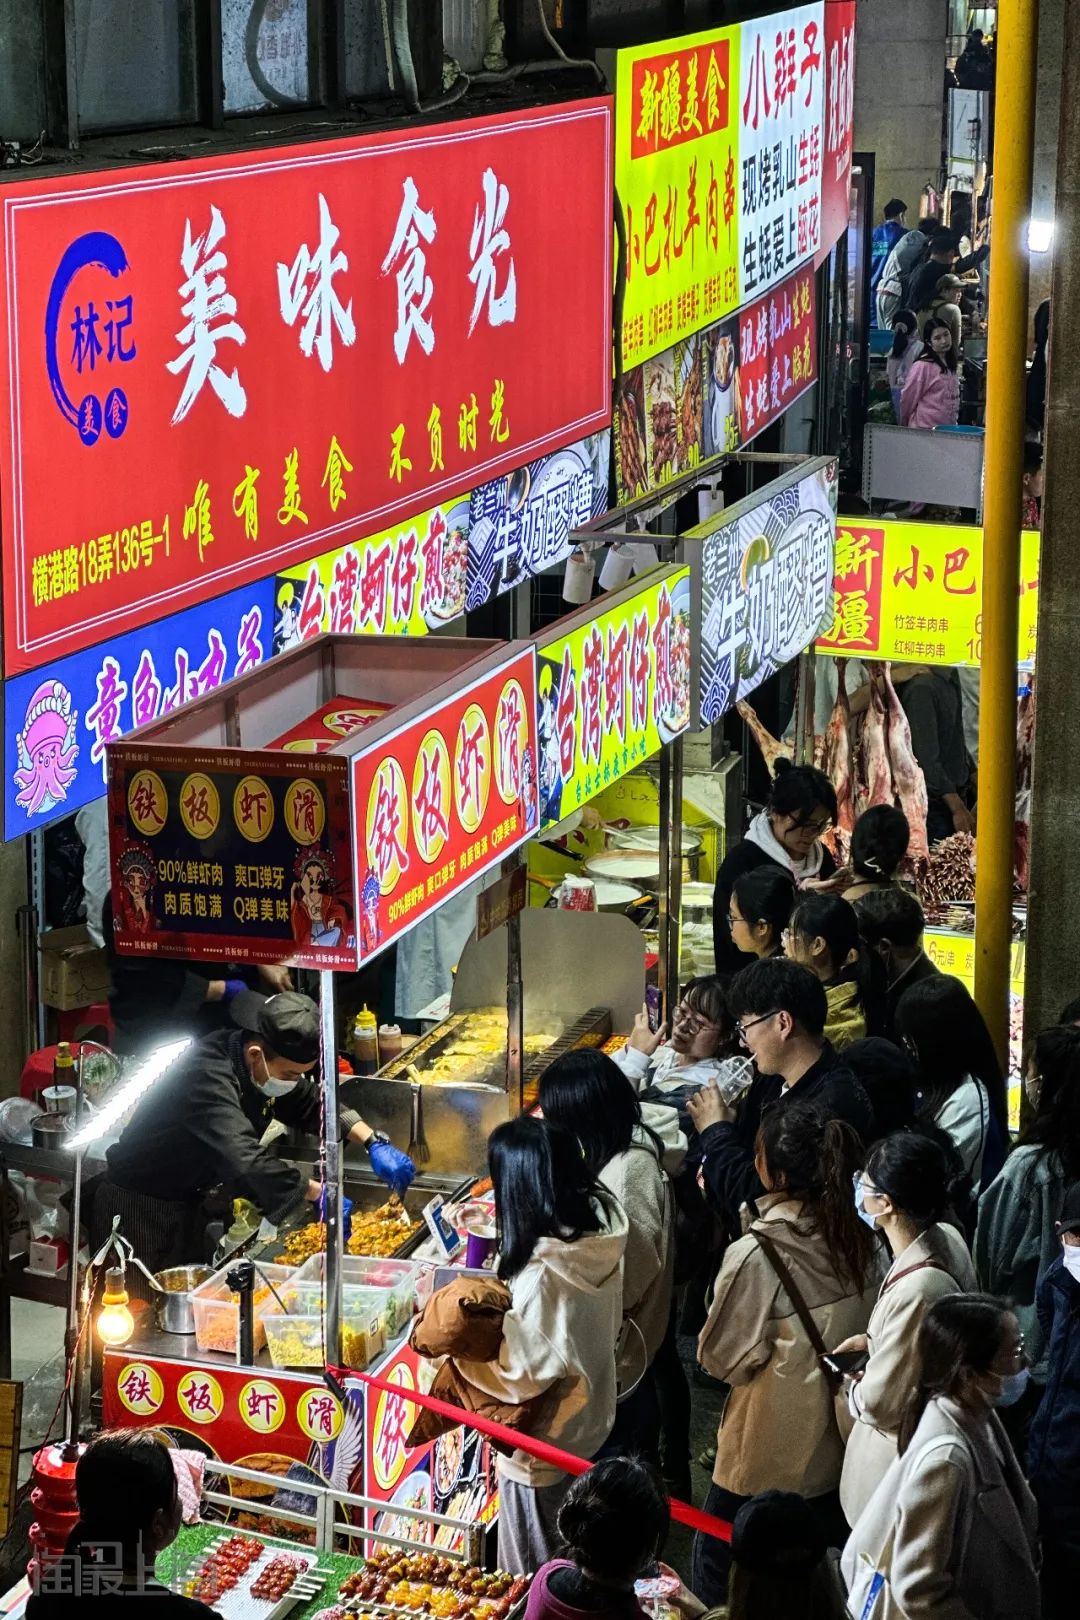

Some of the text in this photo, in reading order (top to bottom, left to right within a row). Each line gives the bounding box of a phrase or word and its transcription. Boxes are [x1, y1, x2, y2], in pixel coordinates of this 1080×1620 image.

[636, 48, 726, 151] 新疆美食
[742, 124, 820, 217] 现烤乳山生蚝
[743, 191, 820, 293] 生蚝爱上脑花
[71, 295, 136, 373] 林记
[166, 167, 517, 425] 美味食光
[741, 276, 812, 366] 现烤乳山生蚝
[80, 391, 126, 436] 美食
[744, 326, 813, 432] 生蚝爱上脑花
[183, 435, 353, 562] 唯有美食
[389, 379, 510, 483] 不负时光
[493, 468, 595, 581] 牛奶醪糟
[705, 525, 740, 584] 老兰州
[299, 510, 447, 641] 台湾蚵仔煎
[718, 515, 830, 686] 牛奶醪糟
[894, 615, 949, 633] 竹签羊肉串
[894, 641, 946, 657] 红柳羊肉串
[556, 583, 673, 779] 台湾蚵仔煎
[128, 777, 319, 842] 铁板虾滑
[372, 687, 522, 882] 铁板虾滑
[158, 859, 285, 890] 90%鲜虾肉 爽口弹牙
[164, 891, 289, 923] 肉质饱满 Q弹美味
[118, 1373, 337, 1437] 铁板虾滑
